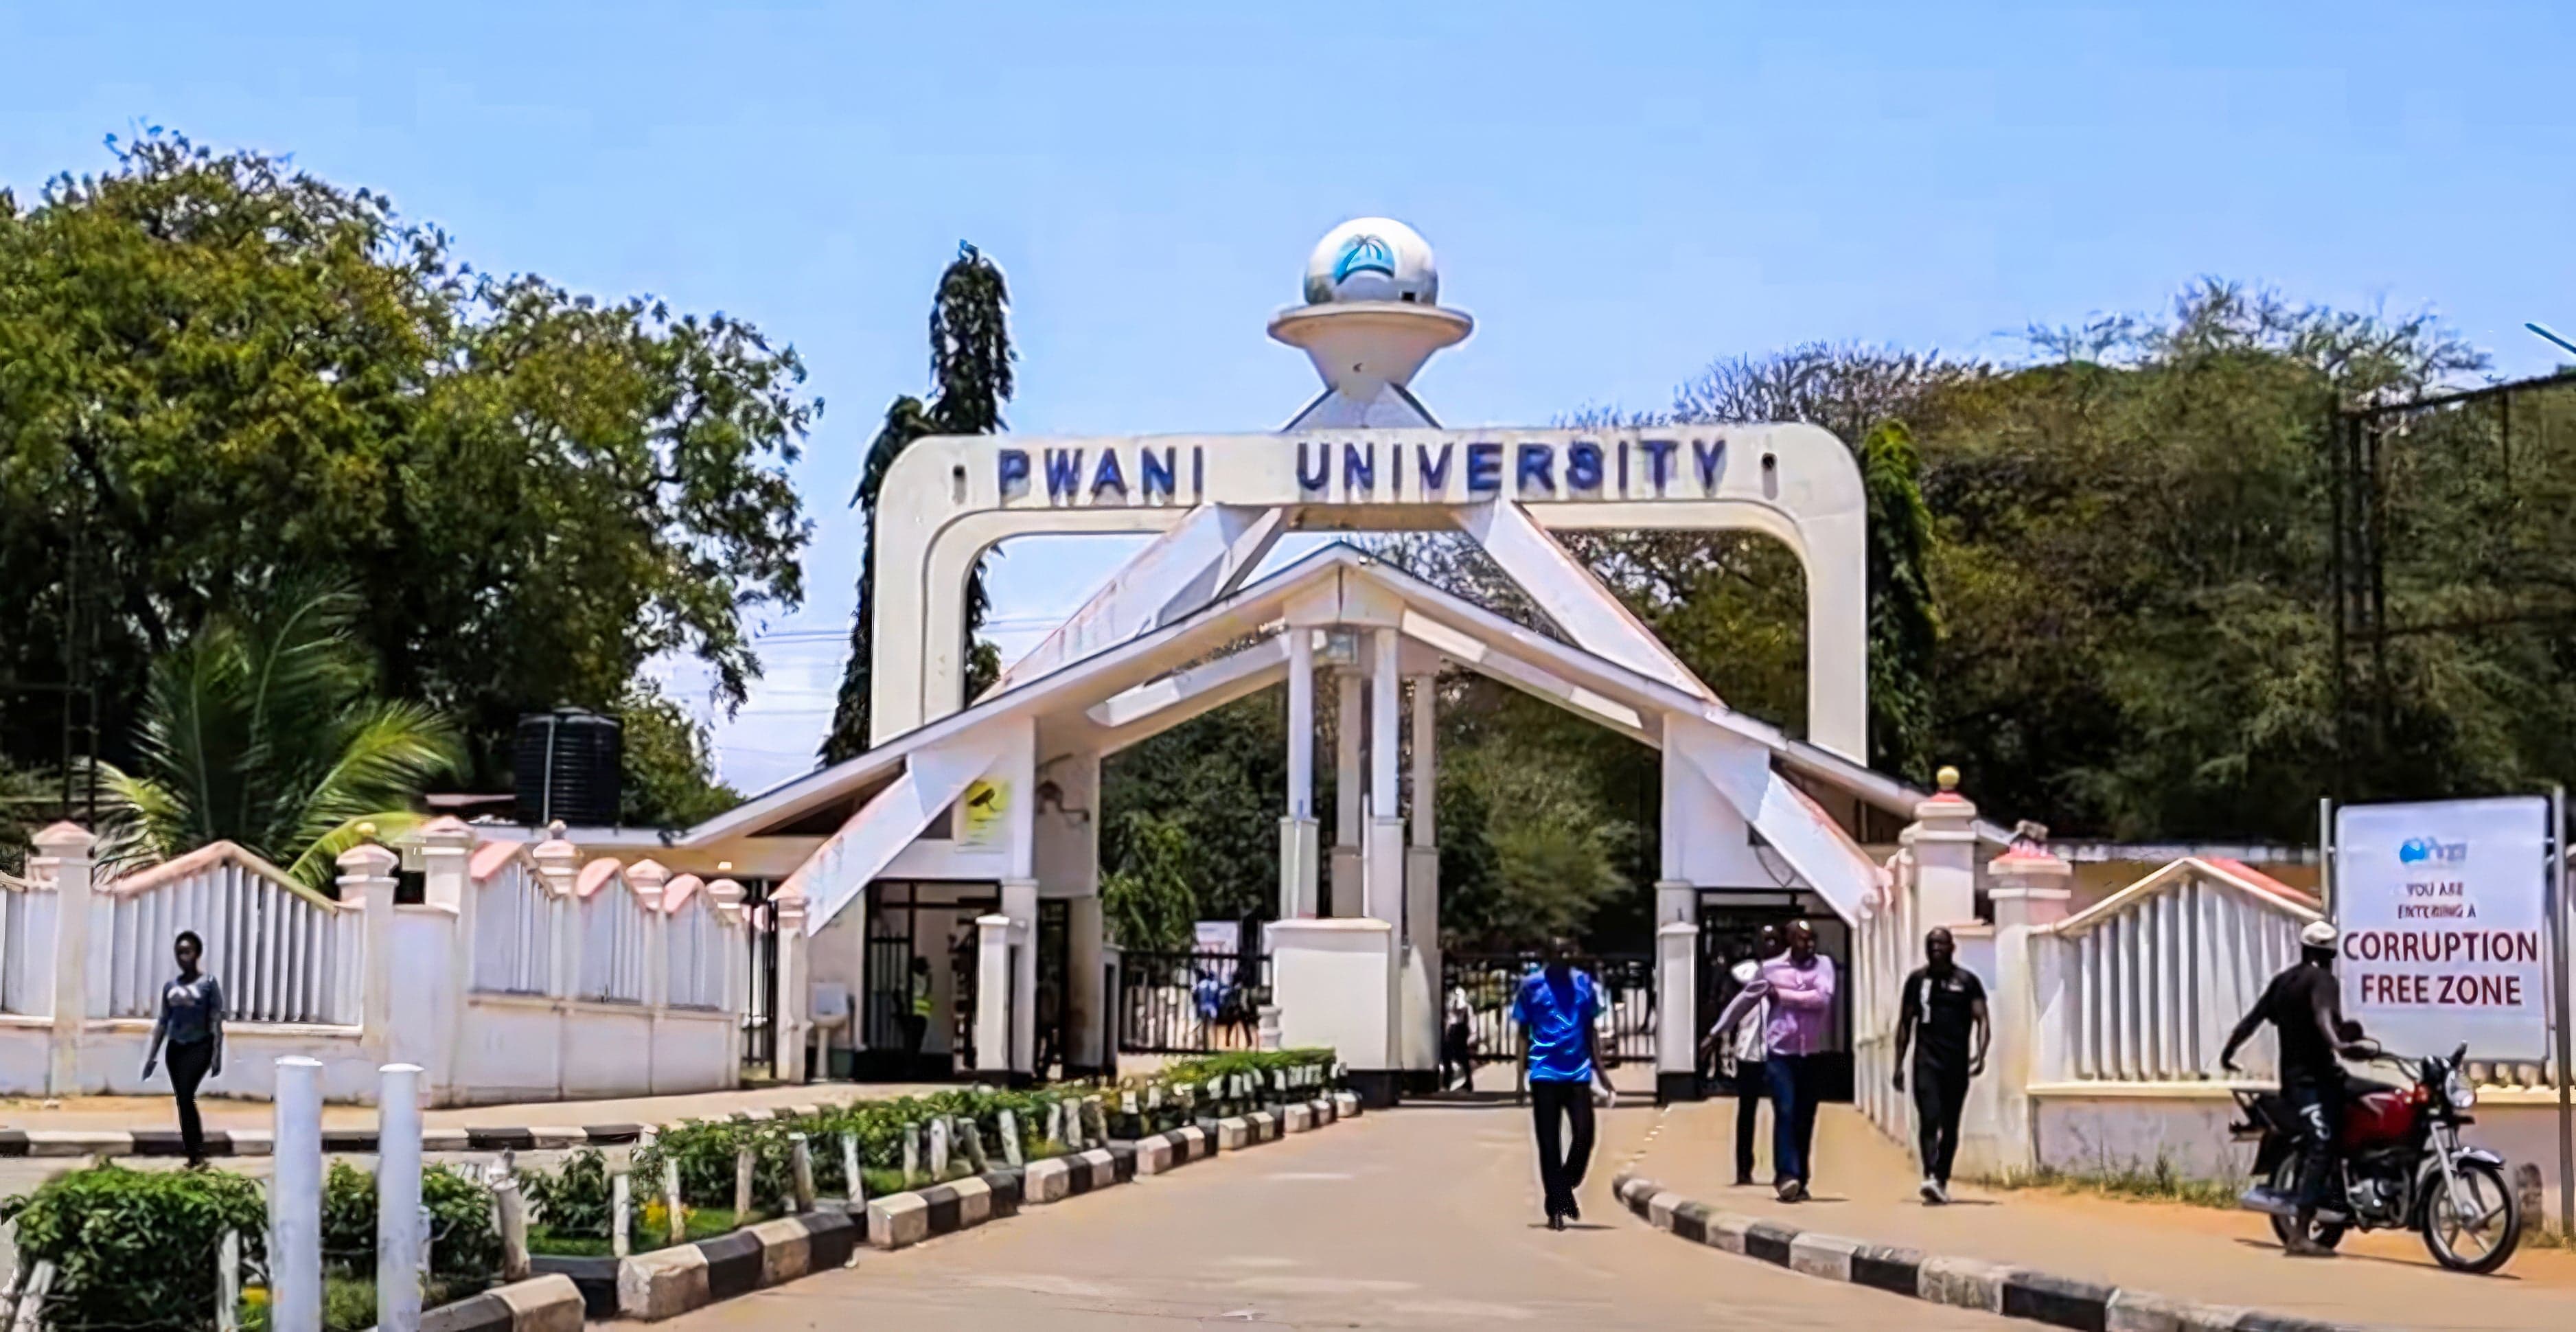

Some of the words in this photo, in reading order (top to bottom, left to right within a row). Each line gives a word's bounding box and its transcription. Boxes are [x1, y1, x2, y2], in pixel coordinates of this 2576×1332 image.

[998, 445, 1203, 496] PWANI
[1296, 439, 1726, 491] UNIVERSITY
[2406, 882, 2434, 896] YOU
[2468, 904, 2476, 917] A
[2343, 932, 2537, 961] CORRUPTION
[2360, 974, 2429, 1004] FREE
[2438, 976, 2522, 1005] ZONE
